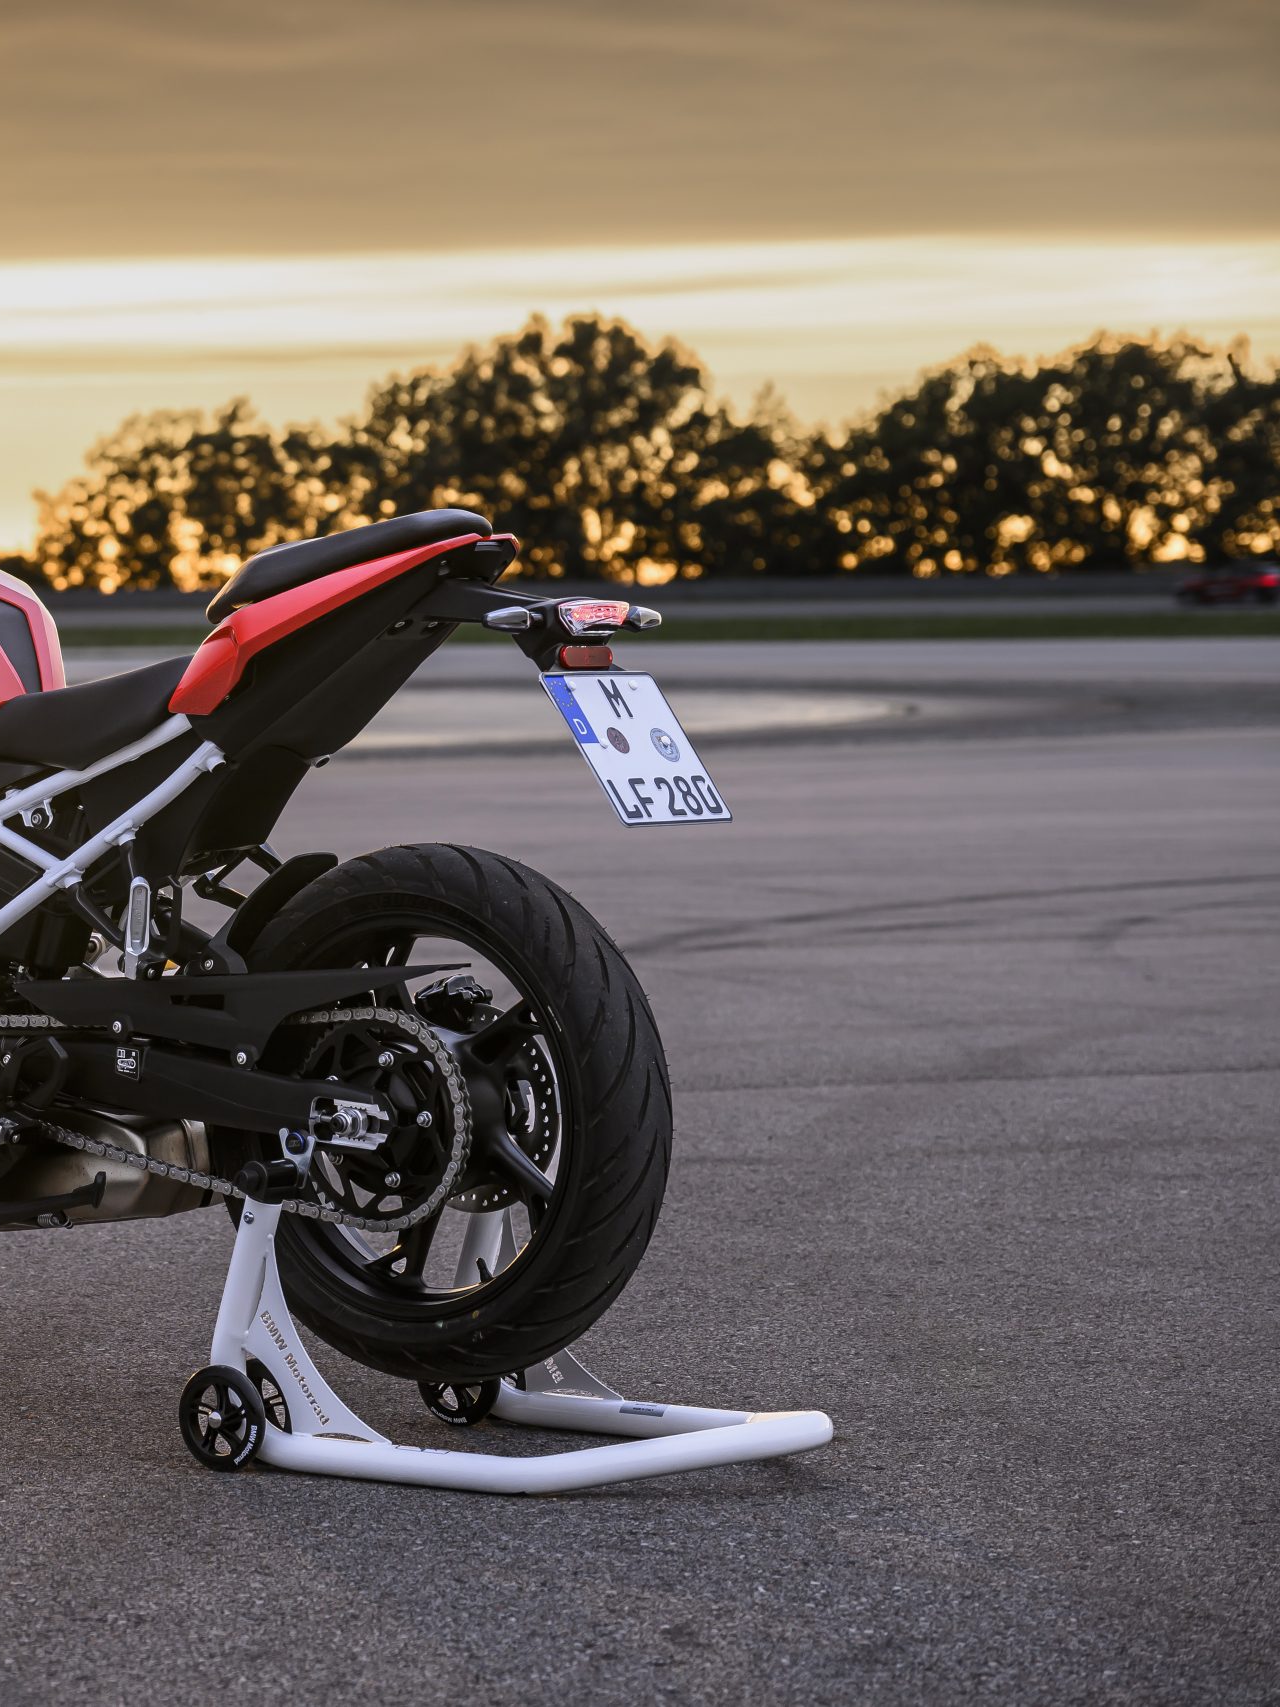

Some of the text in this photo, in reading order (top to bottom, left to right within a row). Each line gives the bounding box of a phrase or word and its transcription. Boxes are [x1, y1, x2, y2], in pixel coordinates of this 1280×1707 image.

[597, 679, 633, 718] M
[573, 718, 587, 734] D
[607, 775, 723, 818] LF 280
[260, 1310, 330, 1426] BMW Motorrad
[233, 1424, 258, 1466] BMW Motorrad
